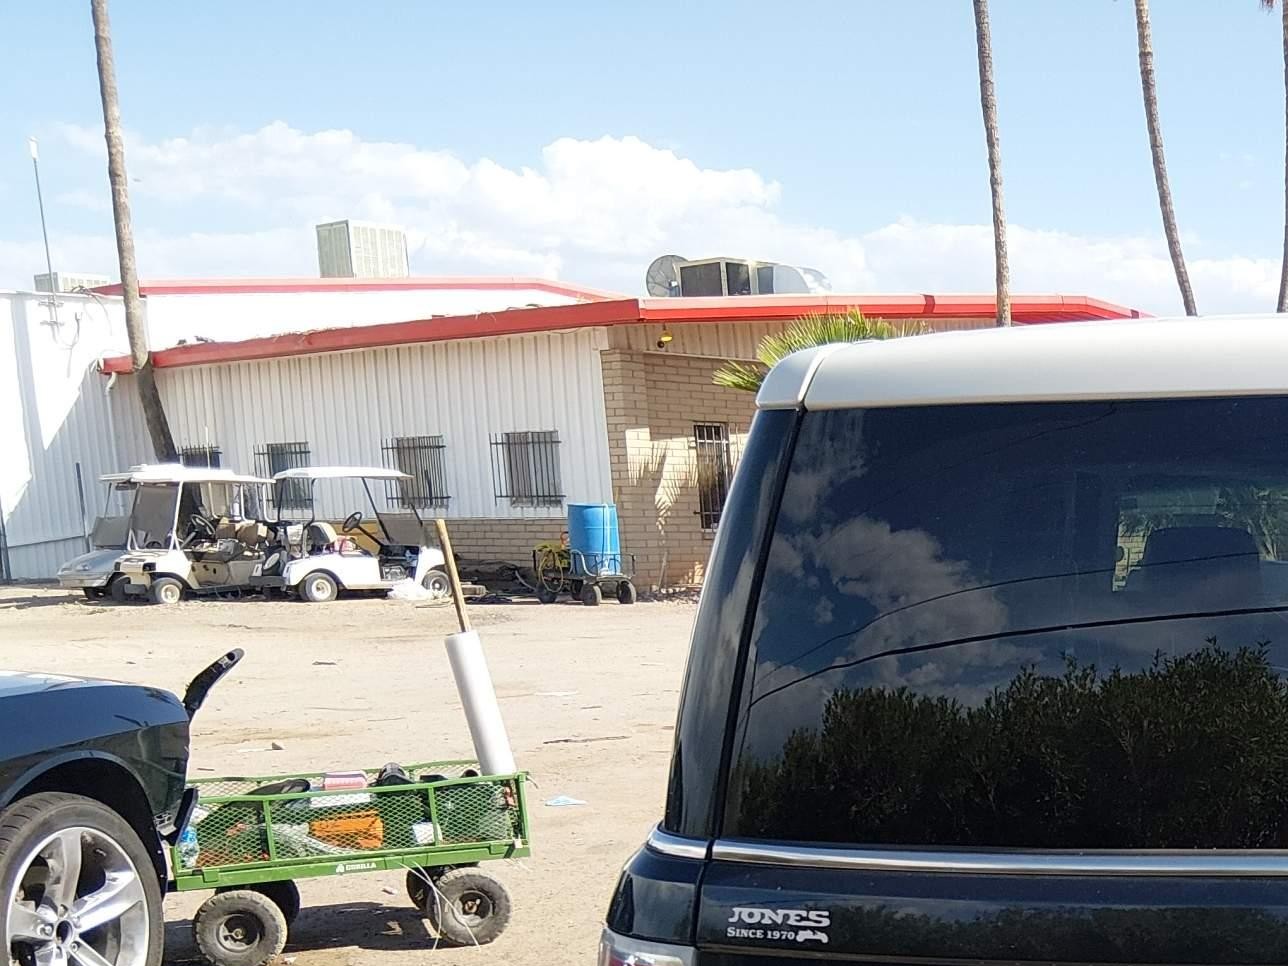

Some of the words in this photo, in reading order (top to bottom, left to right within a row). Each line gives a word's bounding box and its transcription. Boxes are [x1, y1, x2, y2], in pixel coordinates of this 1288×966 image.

[728, 907, 831, 927] JONES
[727, 927, 765, 939] SINCE
[766, 930, 796, 941] 1970
